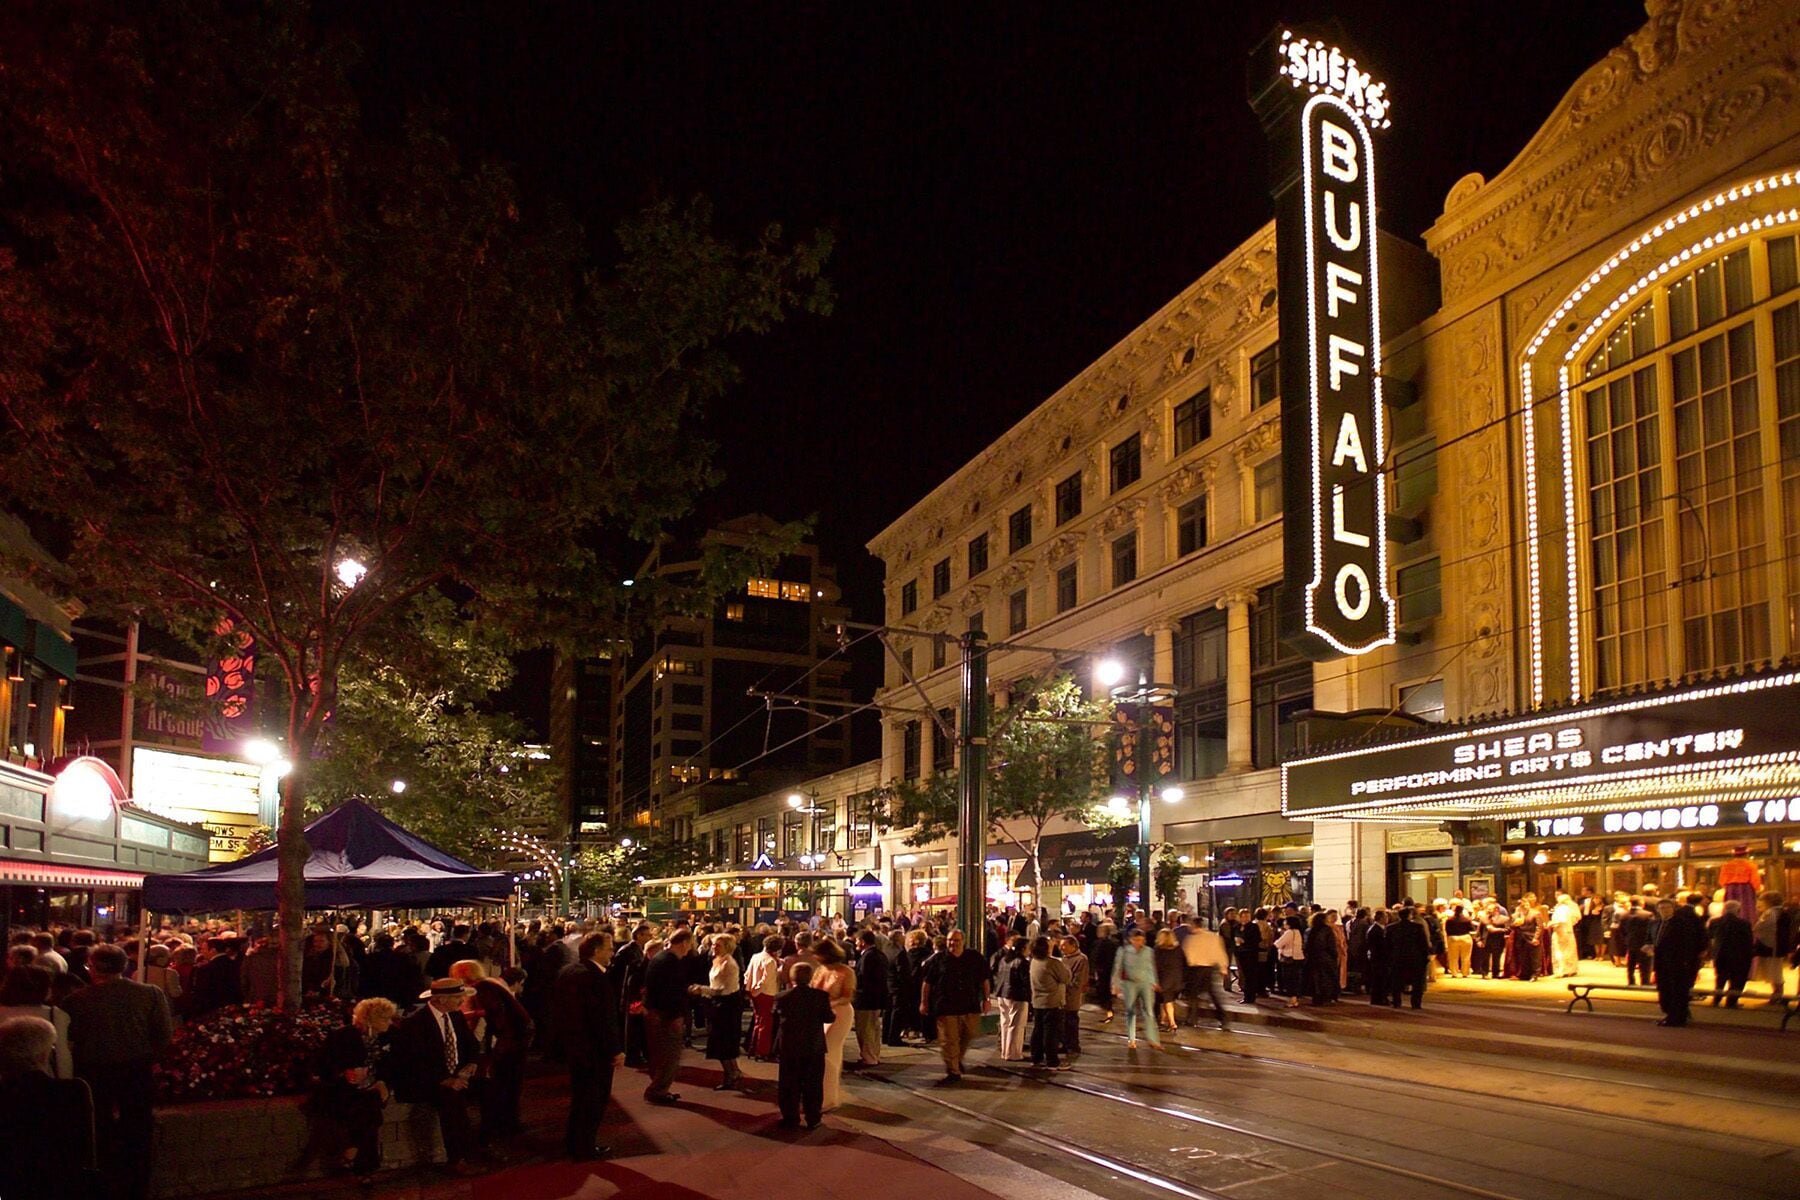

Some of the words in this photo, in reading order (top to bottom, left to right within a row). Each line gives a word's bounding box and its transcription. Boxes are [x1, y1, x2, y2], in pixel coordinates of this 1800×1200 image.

[1321, 119, 1371, 622] BUFFALO
[1351, 763, 1503, 796] PERFORMING
[1510, 751, 1592, 776] ARTS
[1601, 728, 1744, 763] CENTER
[1454, 728, 1583, 764] SHEAS
[1538, 816, 1585, 837] THE
[1603, 804, 1719, 833] WONDER
